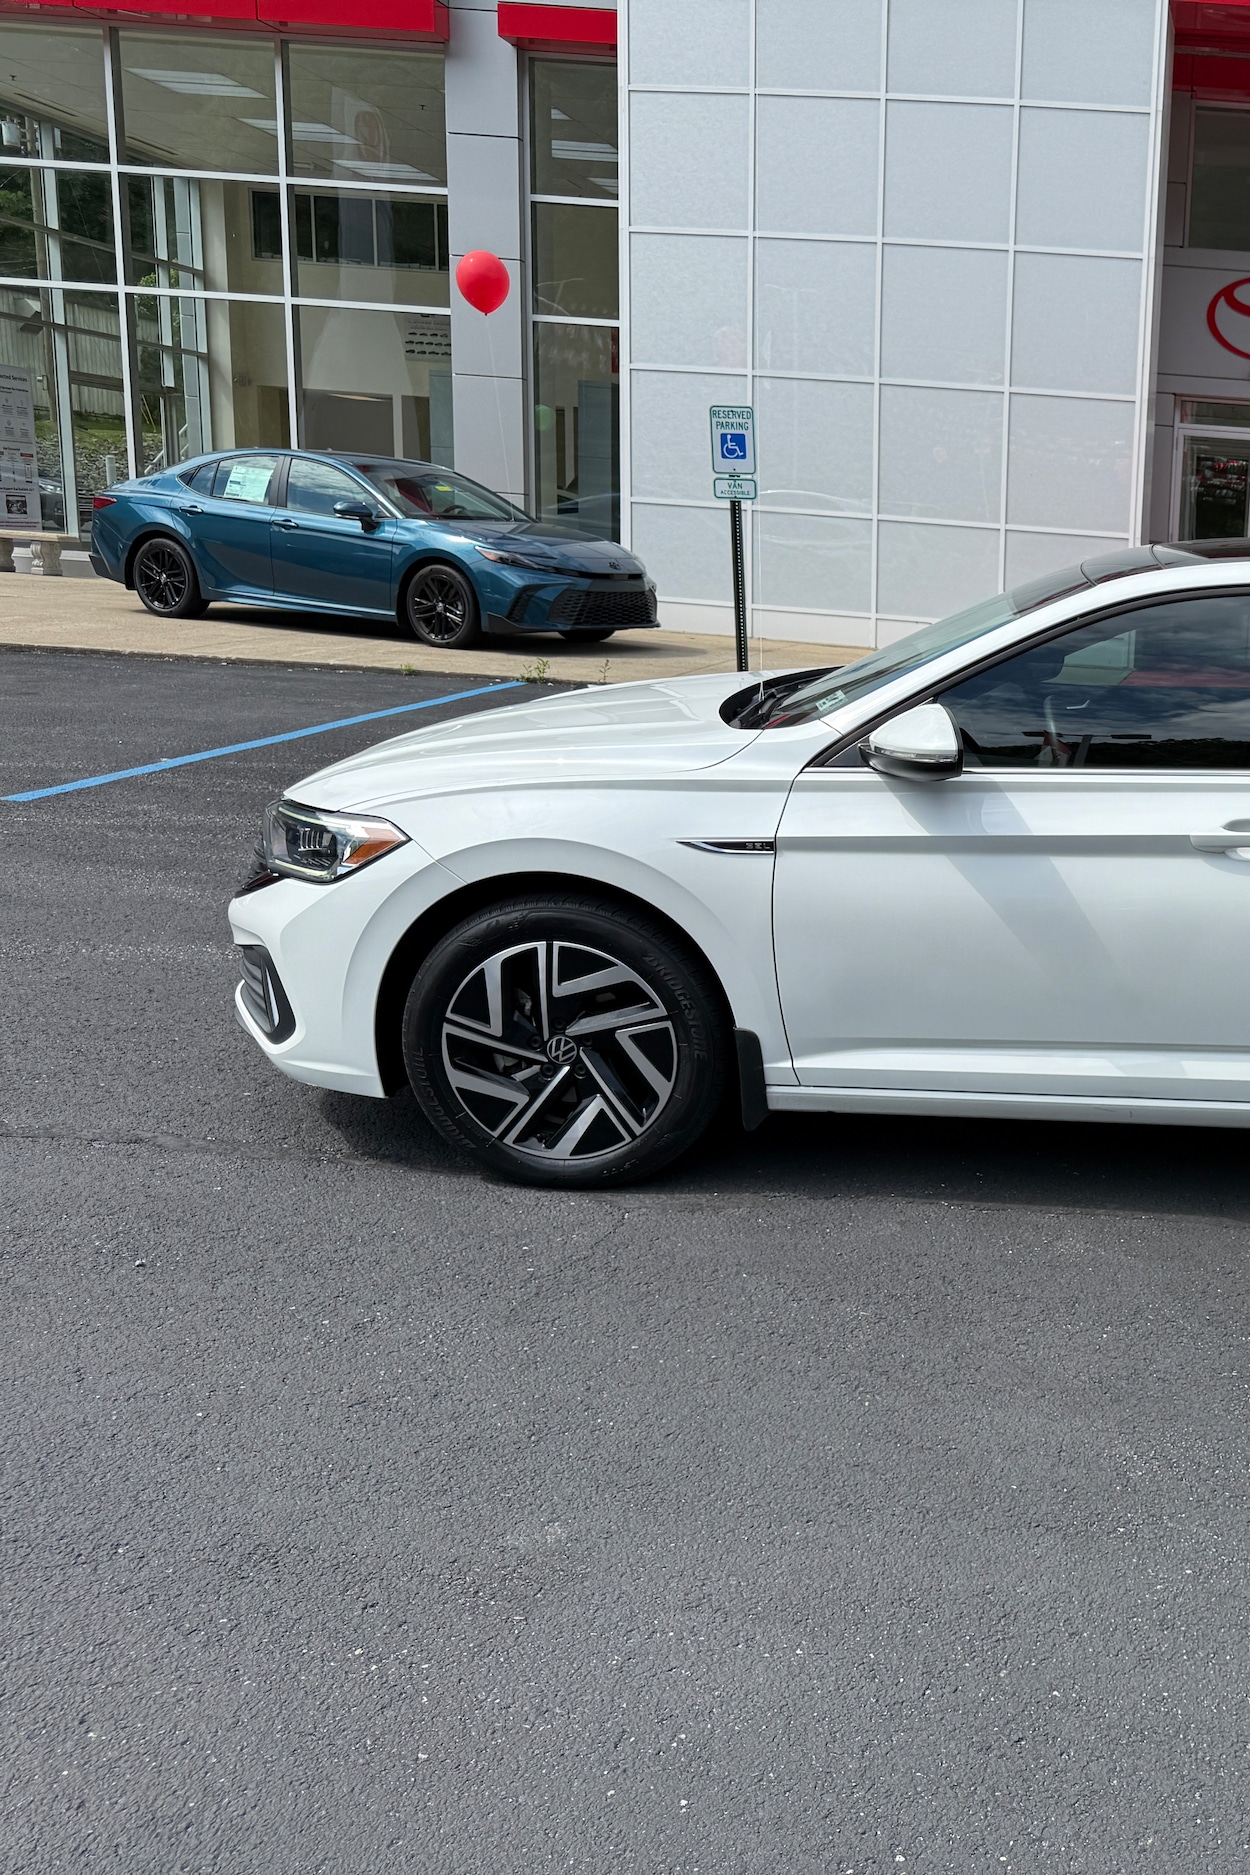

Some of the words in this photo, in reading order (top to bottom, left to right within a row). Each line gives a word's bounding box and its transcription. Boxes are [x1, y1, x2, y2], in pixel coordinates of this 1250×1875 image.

[712, 409, 752, 420] RESERVED
[716, 421, 749, 431] PARKING
[641, 953, 708, 1060] BRIDGESTONE
[412, 1047, 479, 1150] BRIDGESTONE
